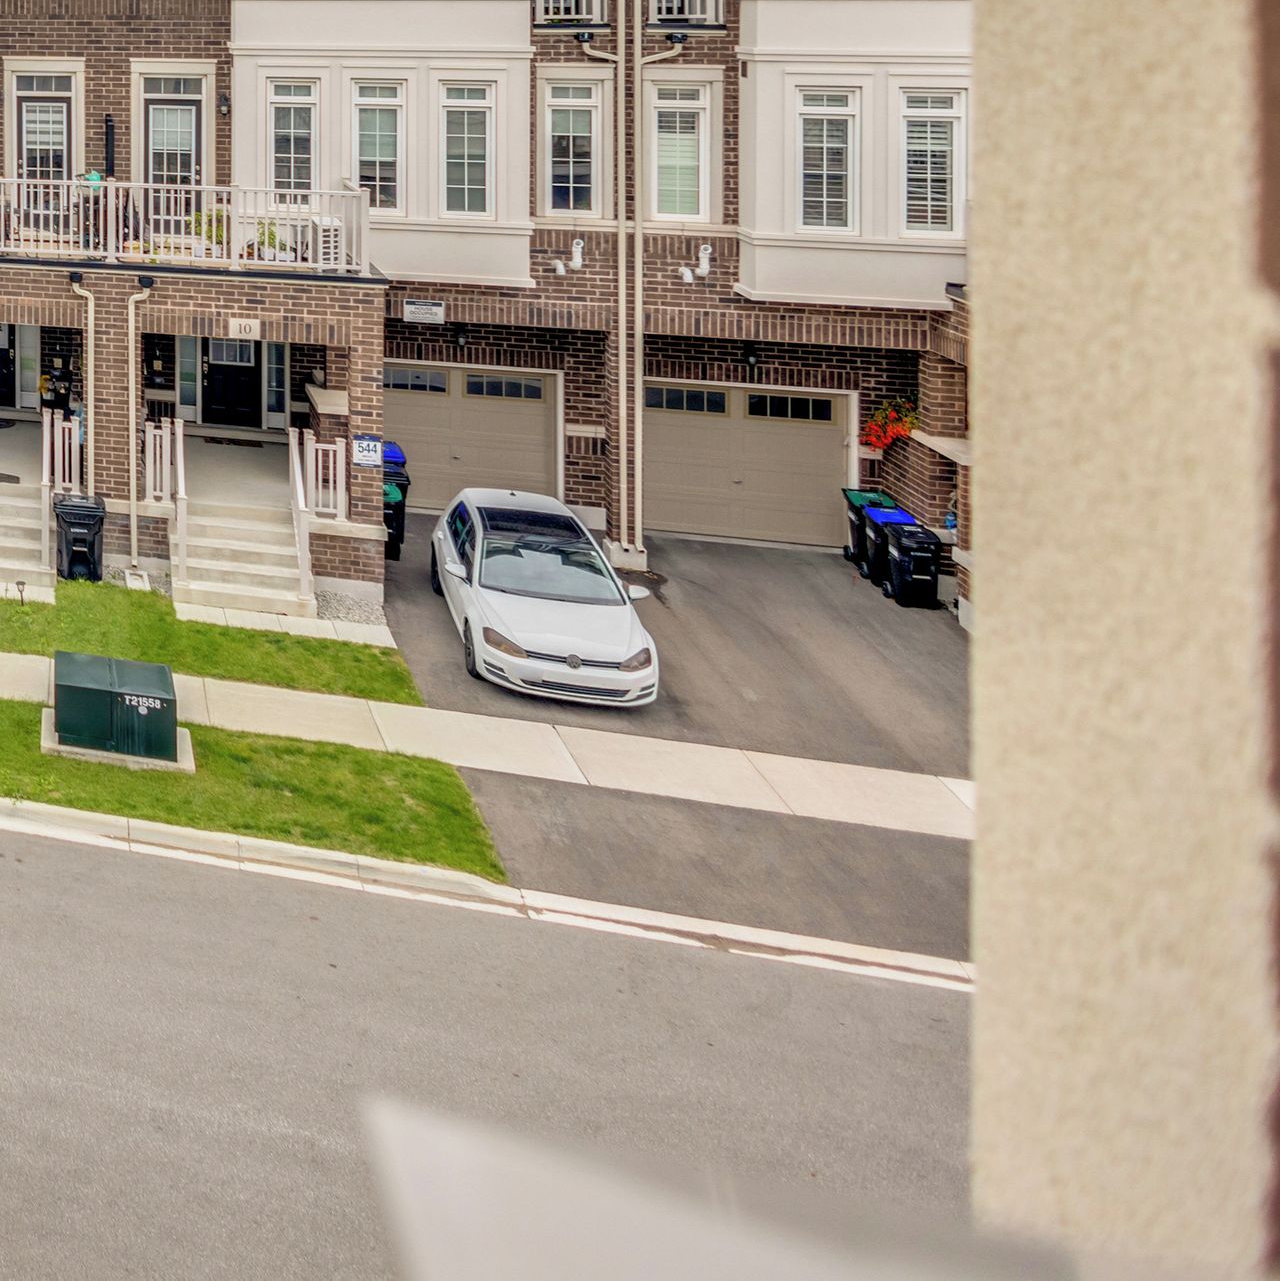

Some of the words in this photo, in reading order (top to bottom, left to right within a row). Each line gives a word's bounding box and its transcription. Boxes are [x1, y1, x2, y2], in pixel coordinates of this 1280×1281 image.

[239, 323, 252, 335] 10
[357, 442, 378, 454] 544
[124, 695, 161, 708] T21558
